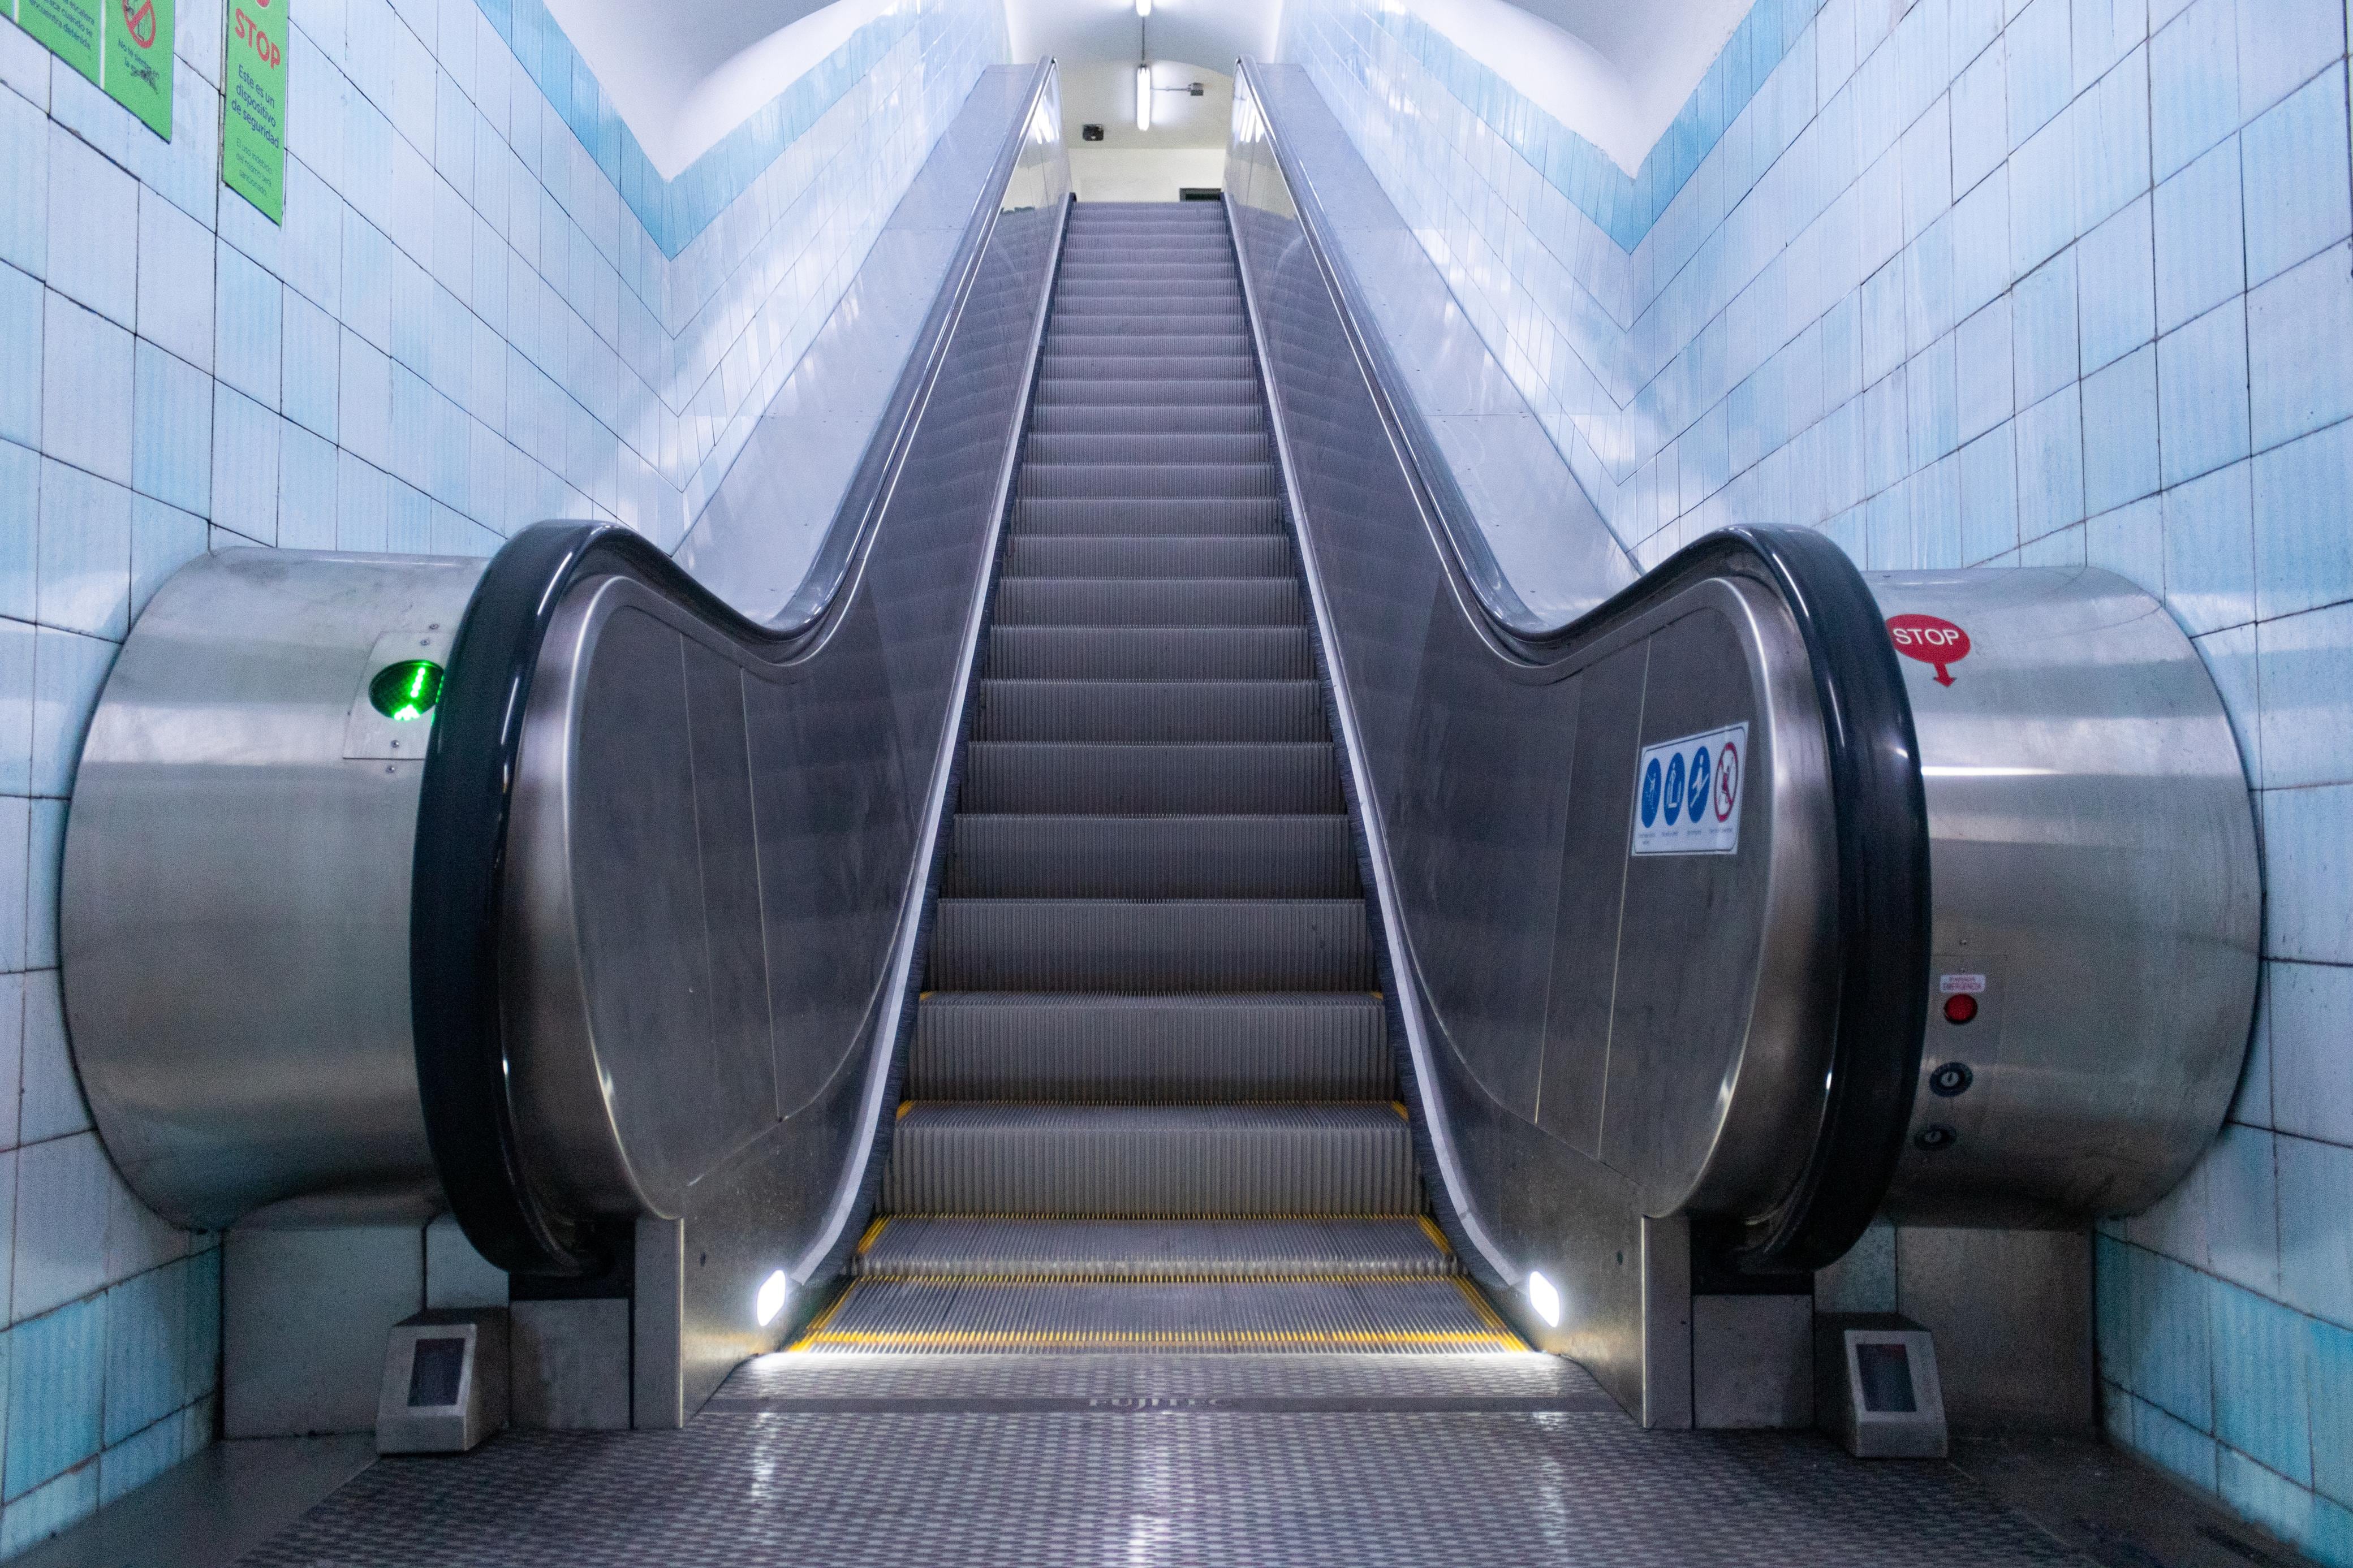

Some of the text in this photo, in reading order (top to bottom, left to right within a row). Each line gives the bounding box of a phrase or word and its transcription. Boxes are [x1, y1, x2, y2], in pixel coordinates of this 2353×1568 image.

[118, 38, 127, 51] No
[235, 8, 281, 69] STOP
[236, 84, 276, 127] dispositivo
[239, 64, 275, 109] Este es un
[231, 99, 279, 149] de seguridad
[1893, 628, 1959, 645] STOP
